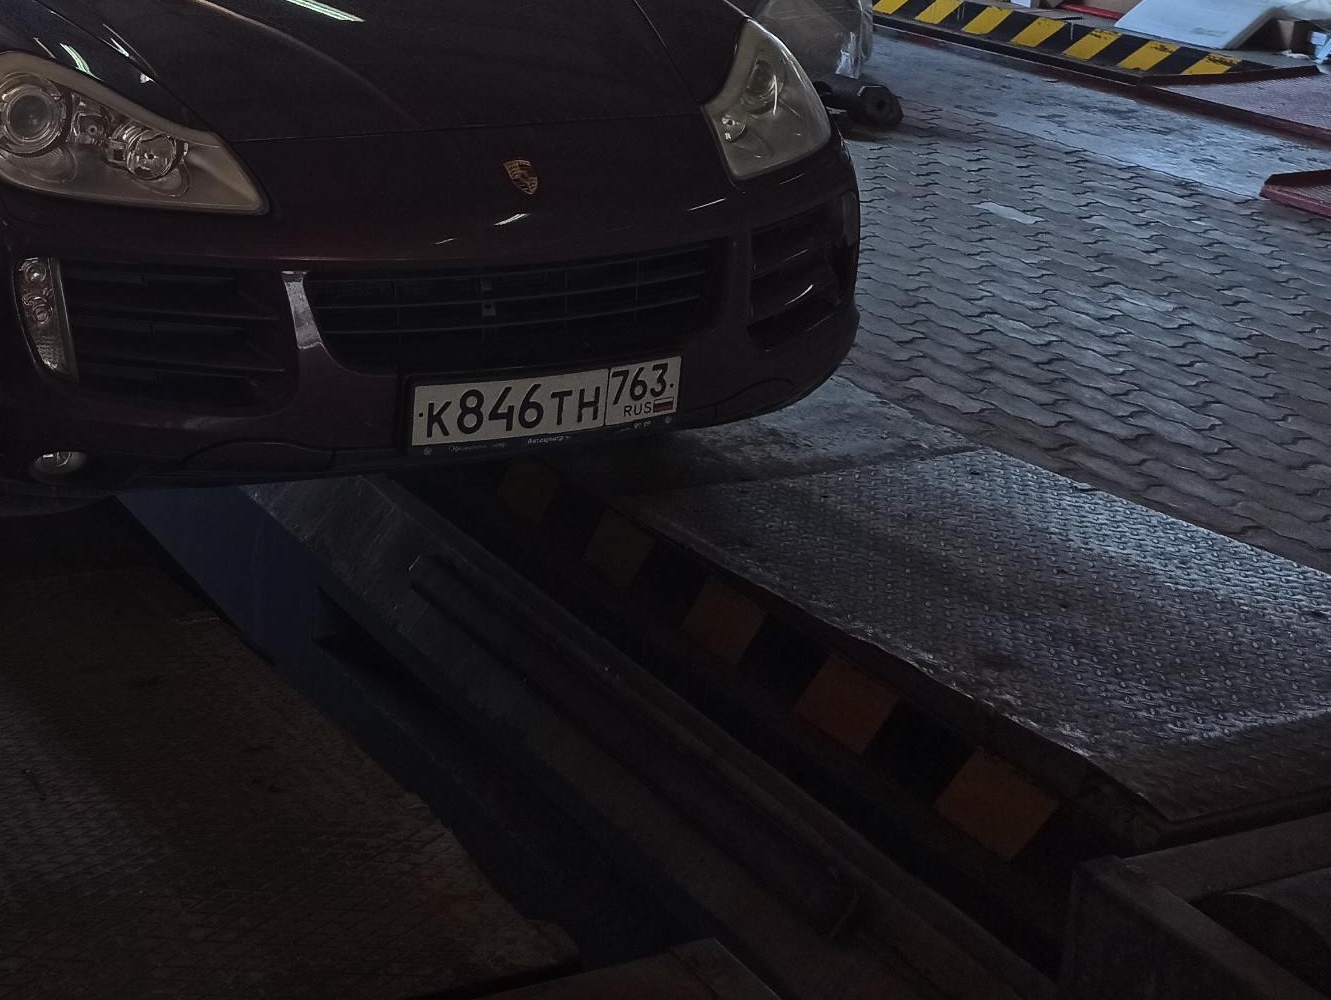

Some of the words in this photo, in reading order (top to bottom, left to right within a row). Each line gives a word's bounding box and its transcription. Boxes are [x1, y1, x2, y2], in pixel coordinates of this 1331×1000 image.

[426, 384, 601, 438] К846ТН
[611, 363, 669, 406] 763
[623, 402, 652, 418] RUS
